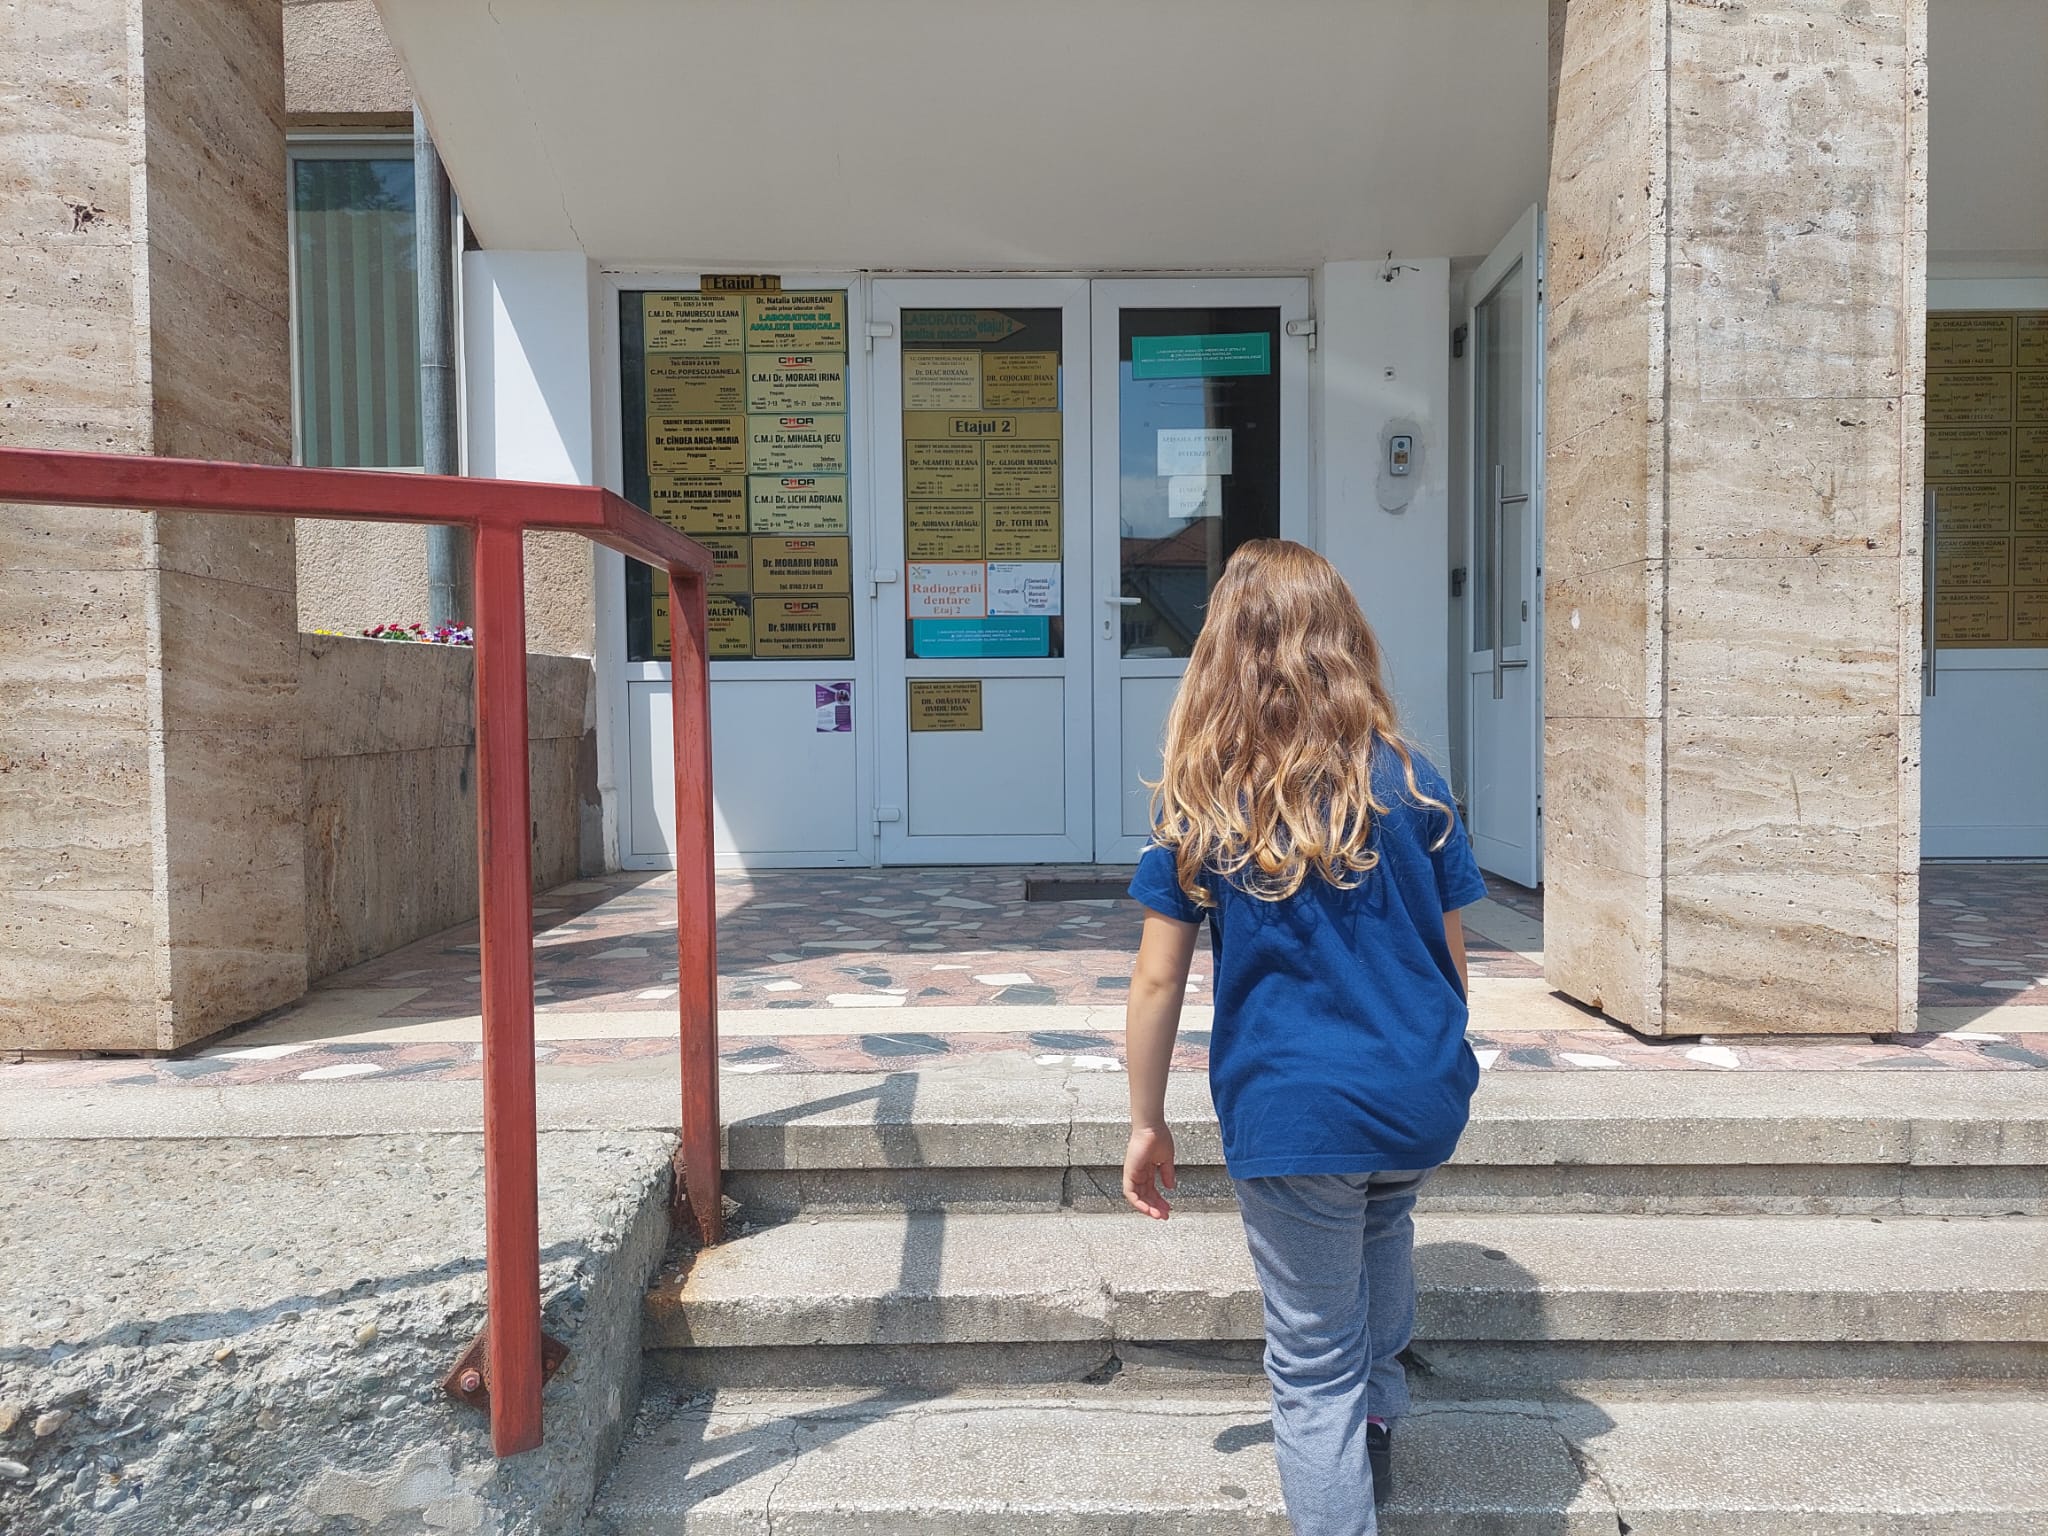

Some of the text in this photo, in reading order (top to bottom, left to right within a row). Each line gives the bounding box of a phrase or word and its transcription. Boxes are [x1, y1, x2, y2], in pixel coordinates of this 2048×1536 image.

[713, 276, 766, 290] Etajul 1
[759, 313, 831, 322] LABORATOR DE
[904, 314, 977, 326] LABORATOR
[977, 318, 1014, 337] etajul 2
[904, 328, 976, 340] analize medicale
[773, 374, 784, 382] Dr.
[786, 374, 816, 382] MORARI
[819, 374, 840, 382] IRINA
[956, 420, 1011, 435] Etajul 2
[656, 436, 666, 444] Dr.
[694, 436, 740, 444] ANCA-MARIA
[776, 434, 786, 443] Dr.
[788, 434, 822, 443] MIHAELA
[672, 490, 682, 498] Dr.
[714, 490, 742, 498] SIMONA
[776, 495, 786, 504] Dr.
[788, 495, 808, 504] LICHI
[809, 495, 842, 504] ADRIANA
[763, 558, 839, 568] Dr. MORARIU HORIA
[912, 584, 982, 594] Radiografii
[924, 596, 970, 605] dentare
[934, 606, 953, 615] Etaj
[768, 623, 836, 632] Dr. SIMINEL PETRU
